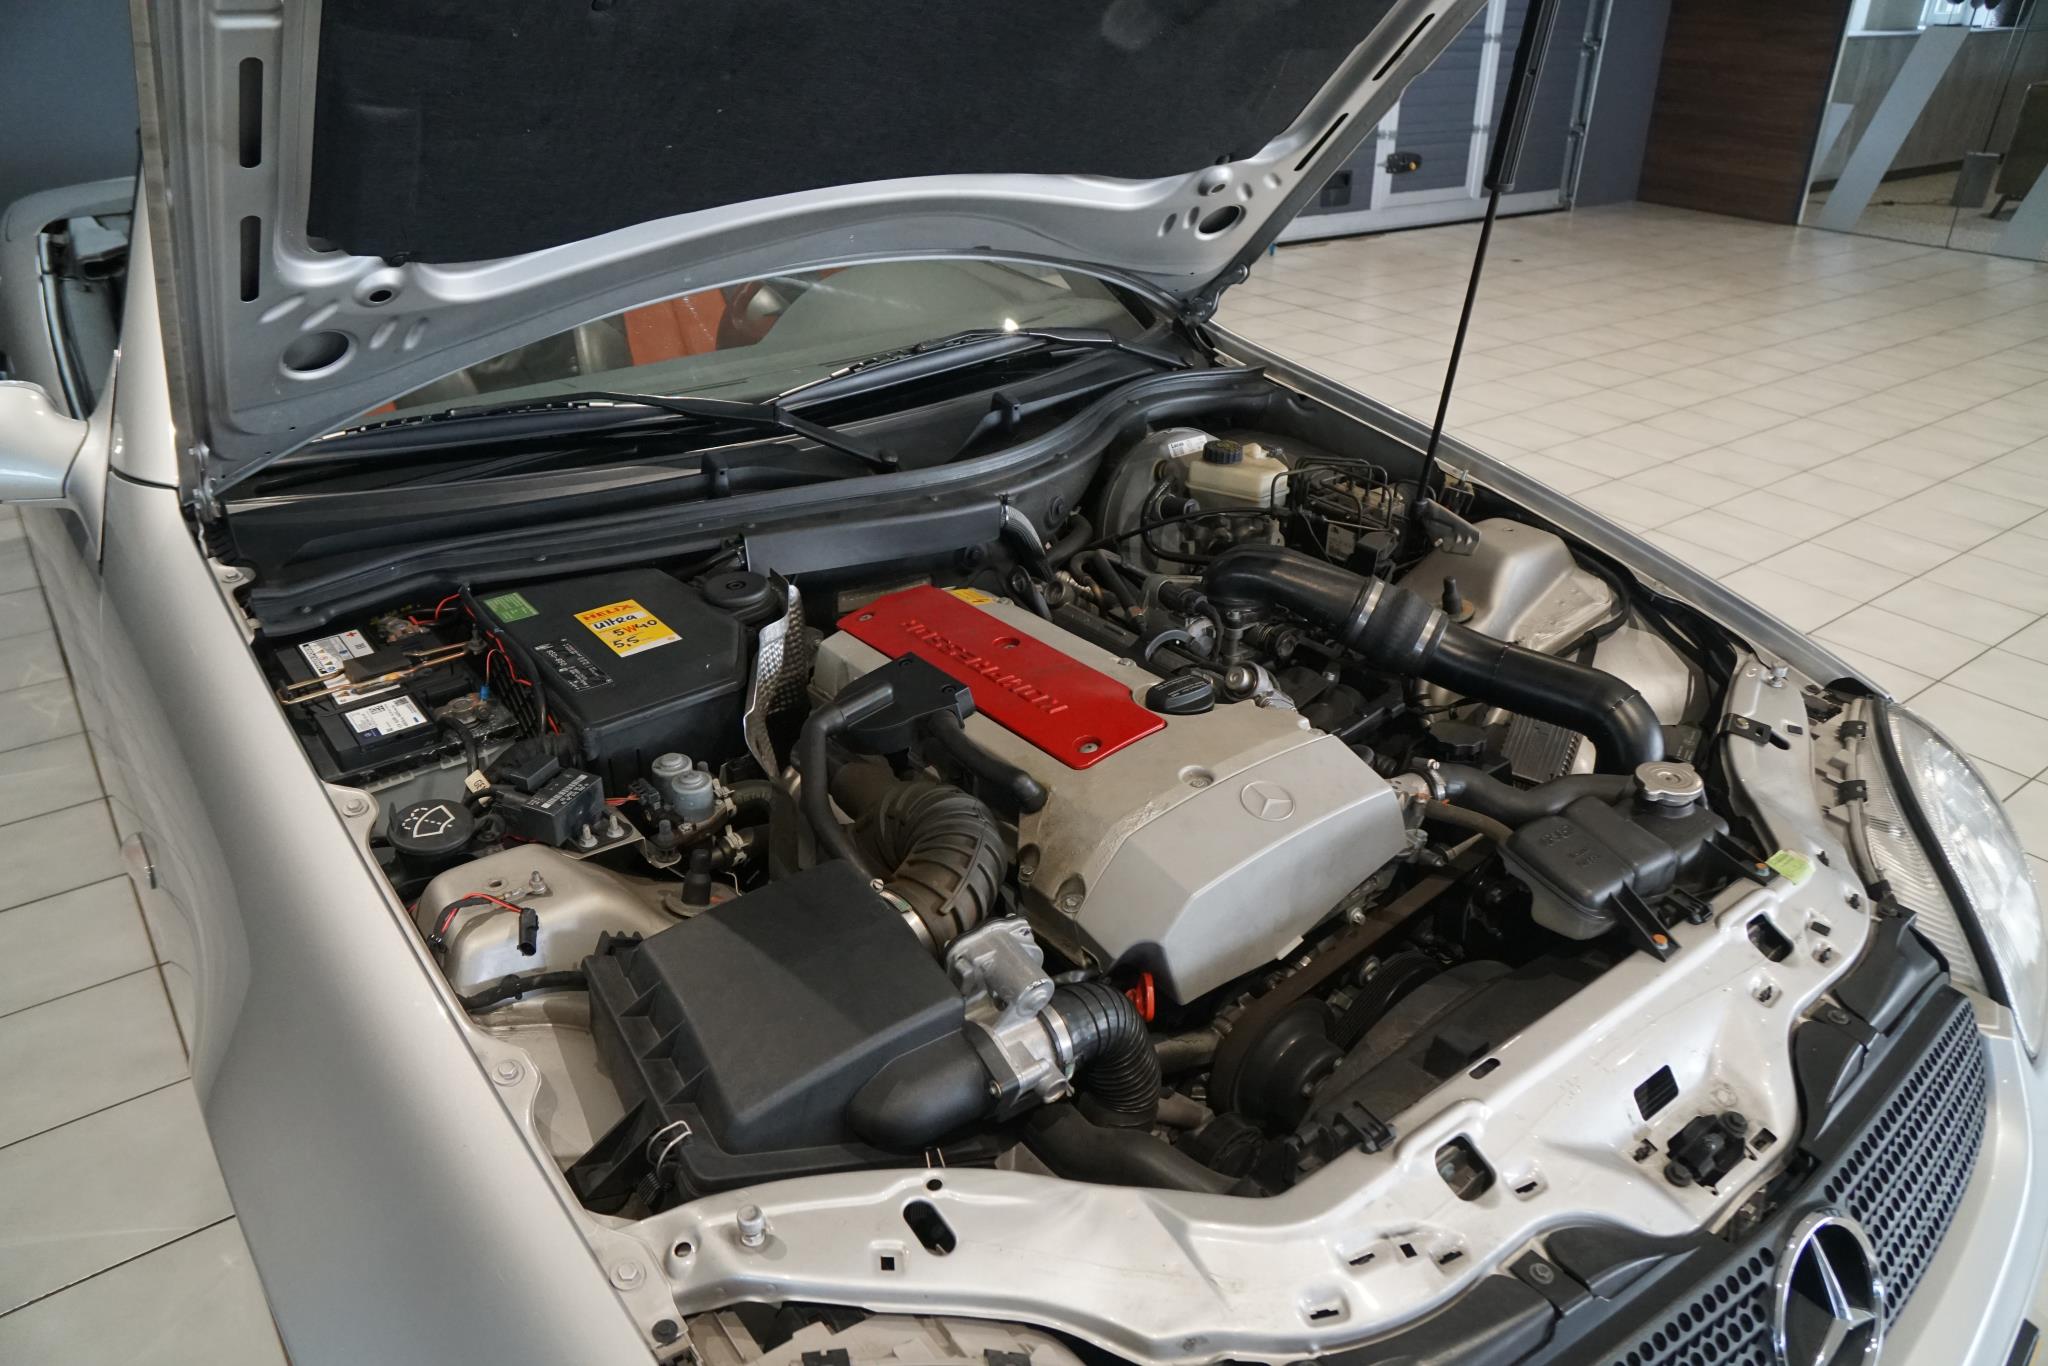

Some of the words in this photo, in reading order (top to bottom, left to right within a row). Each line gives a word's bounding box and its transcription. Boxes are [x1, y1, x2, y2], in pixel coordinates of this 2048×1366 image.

[583, 604, 634, 621] HELIX
[613, 619, 658, 637] 5W40
[613, 635, 640, 649] 5,5
[901, 618, 1069, 715] KOMPRESSOR
